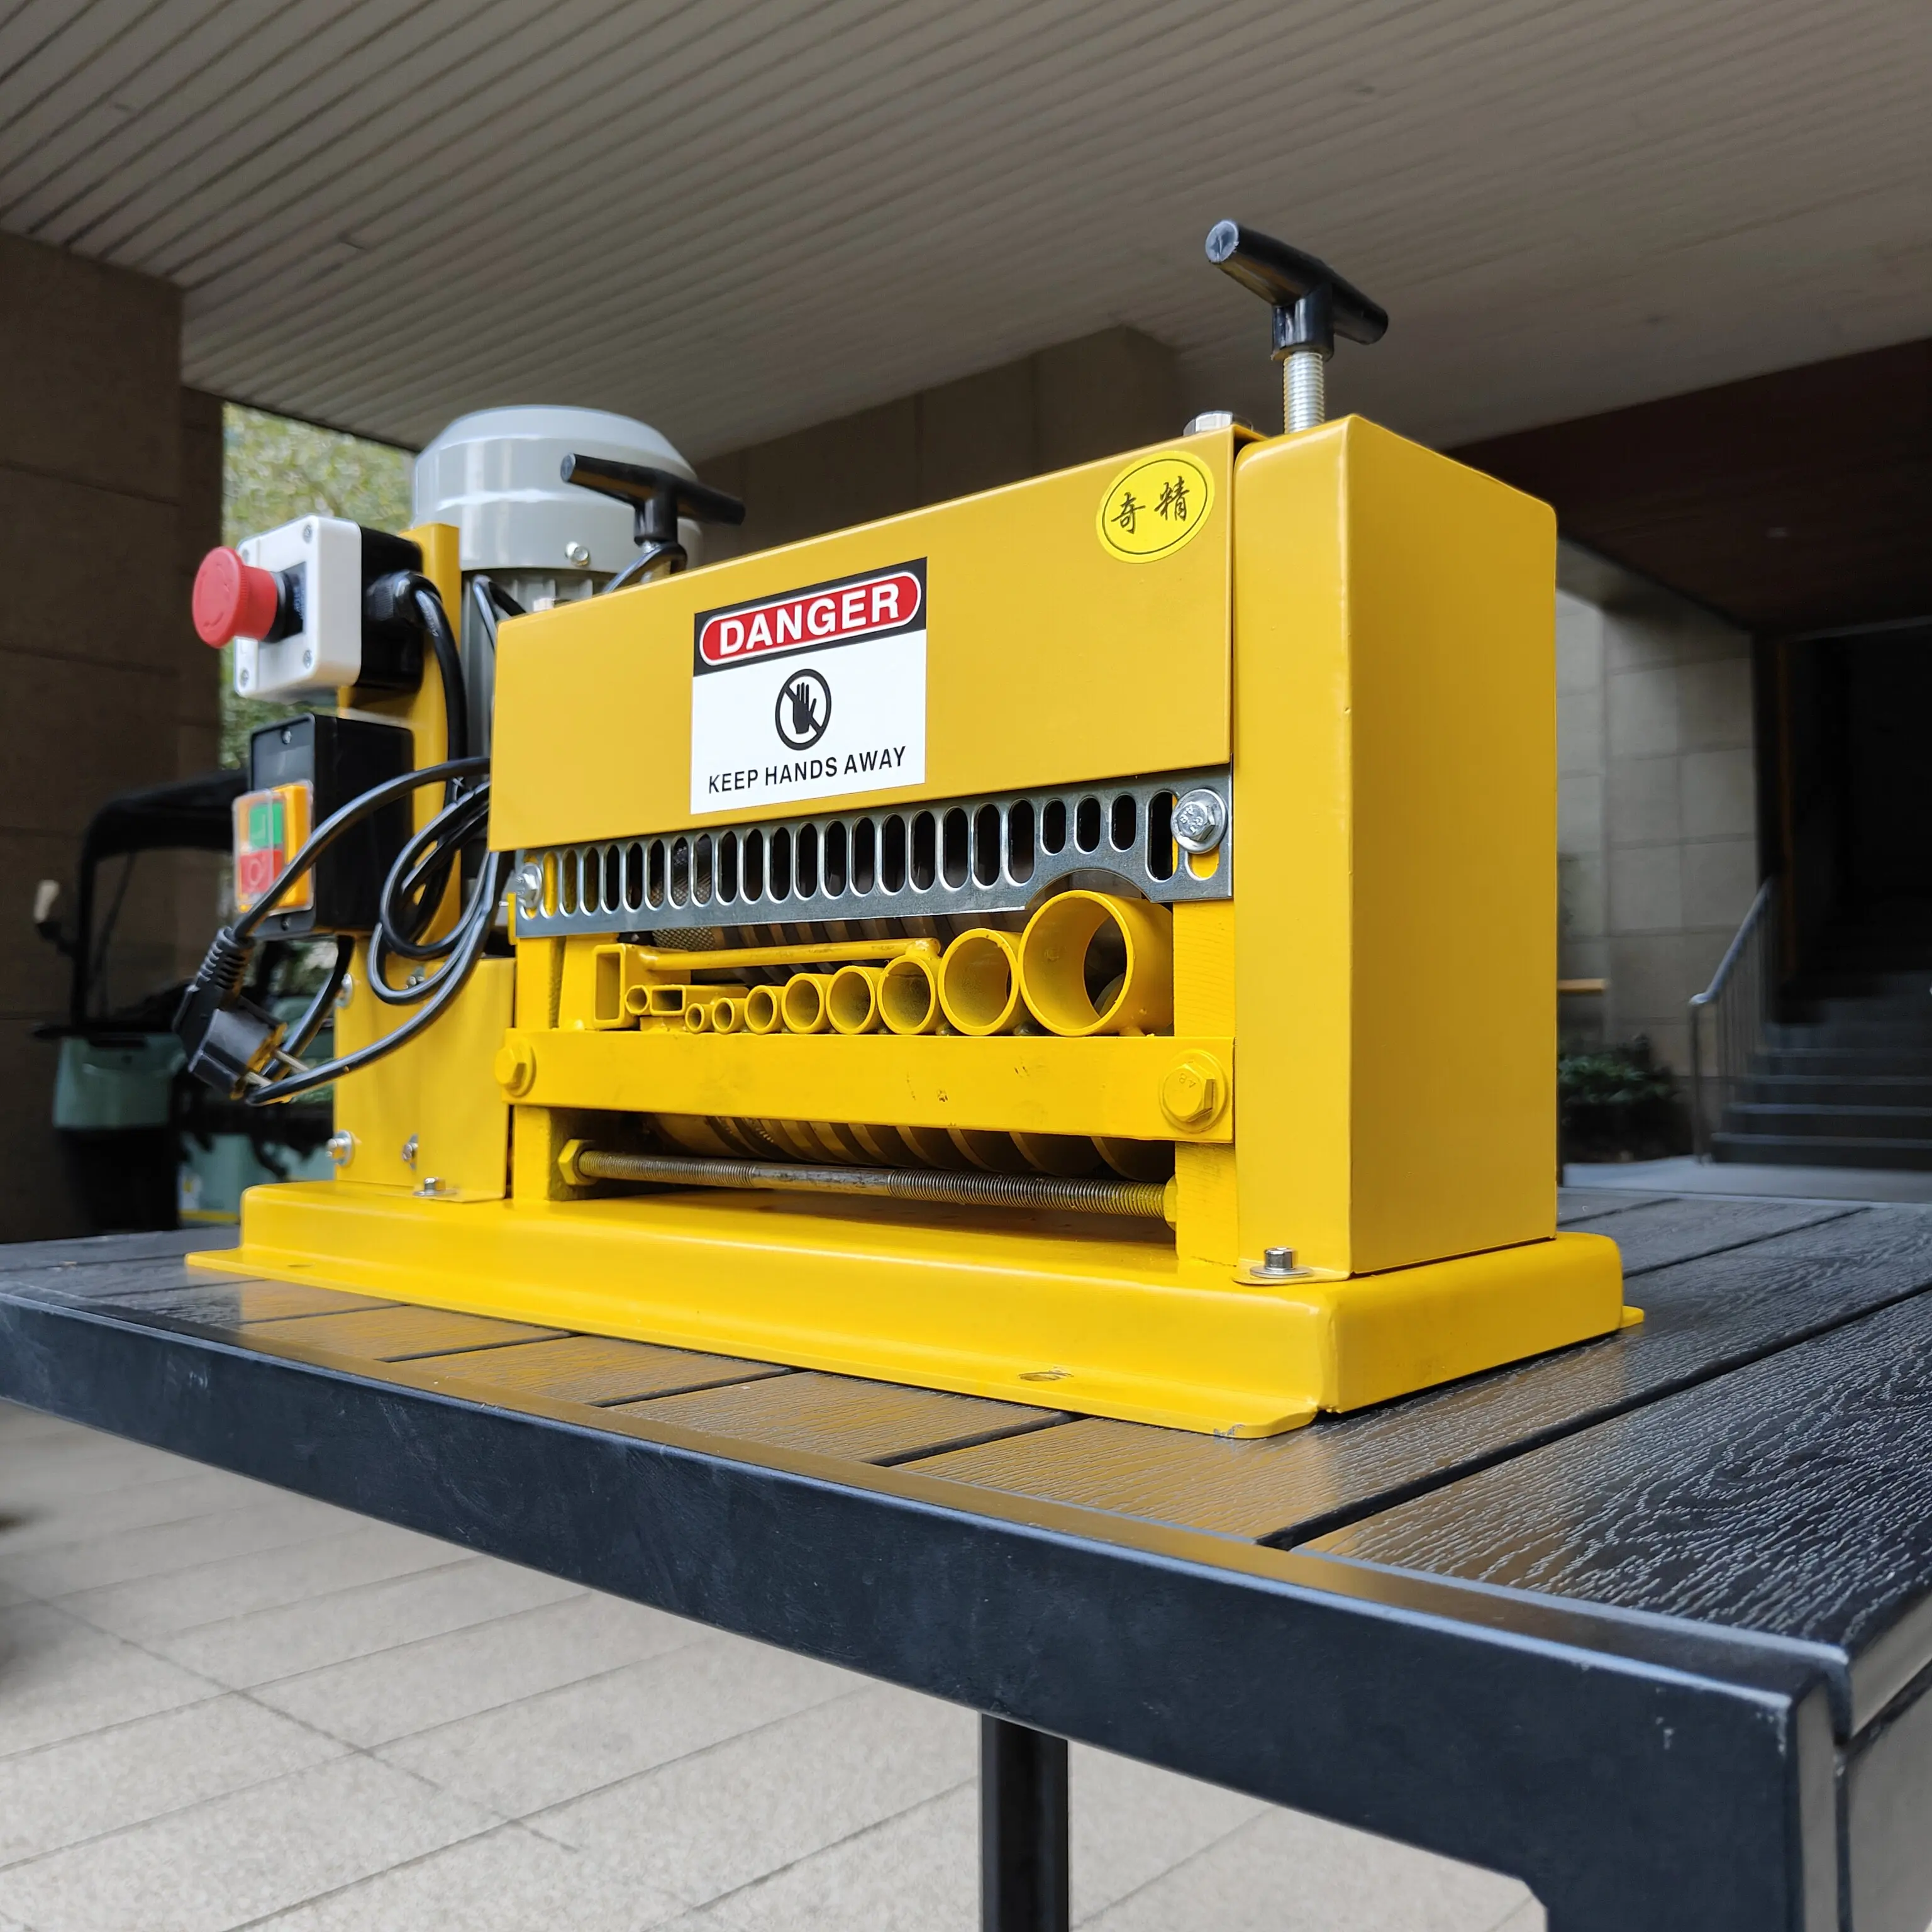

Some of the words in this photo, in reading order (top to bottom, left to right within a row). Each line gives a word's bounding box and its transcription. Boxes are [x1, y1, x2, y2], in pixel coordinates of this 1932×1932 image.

[719, 582, 899, 656] DANGER
[708, 769, 758, 794] KEEP
[765, 757, 838, 786] HANDS
[843, 746, 906, 775] AWAY
